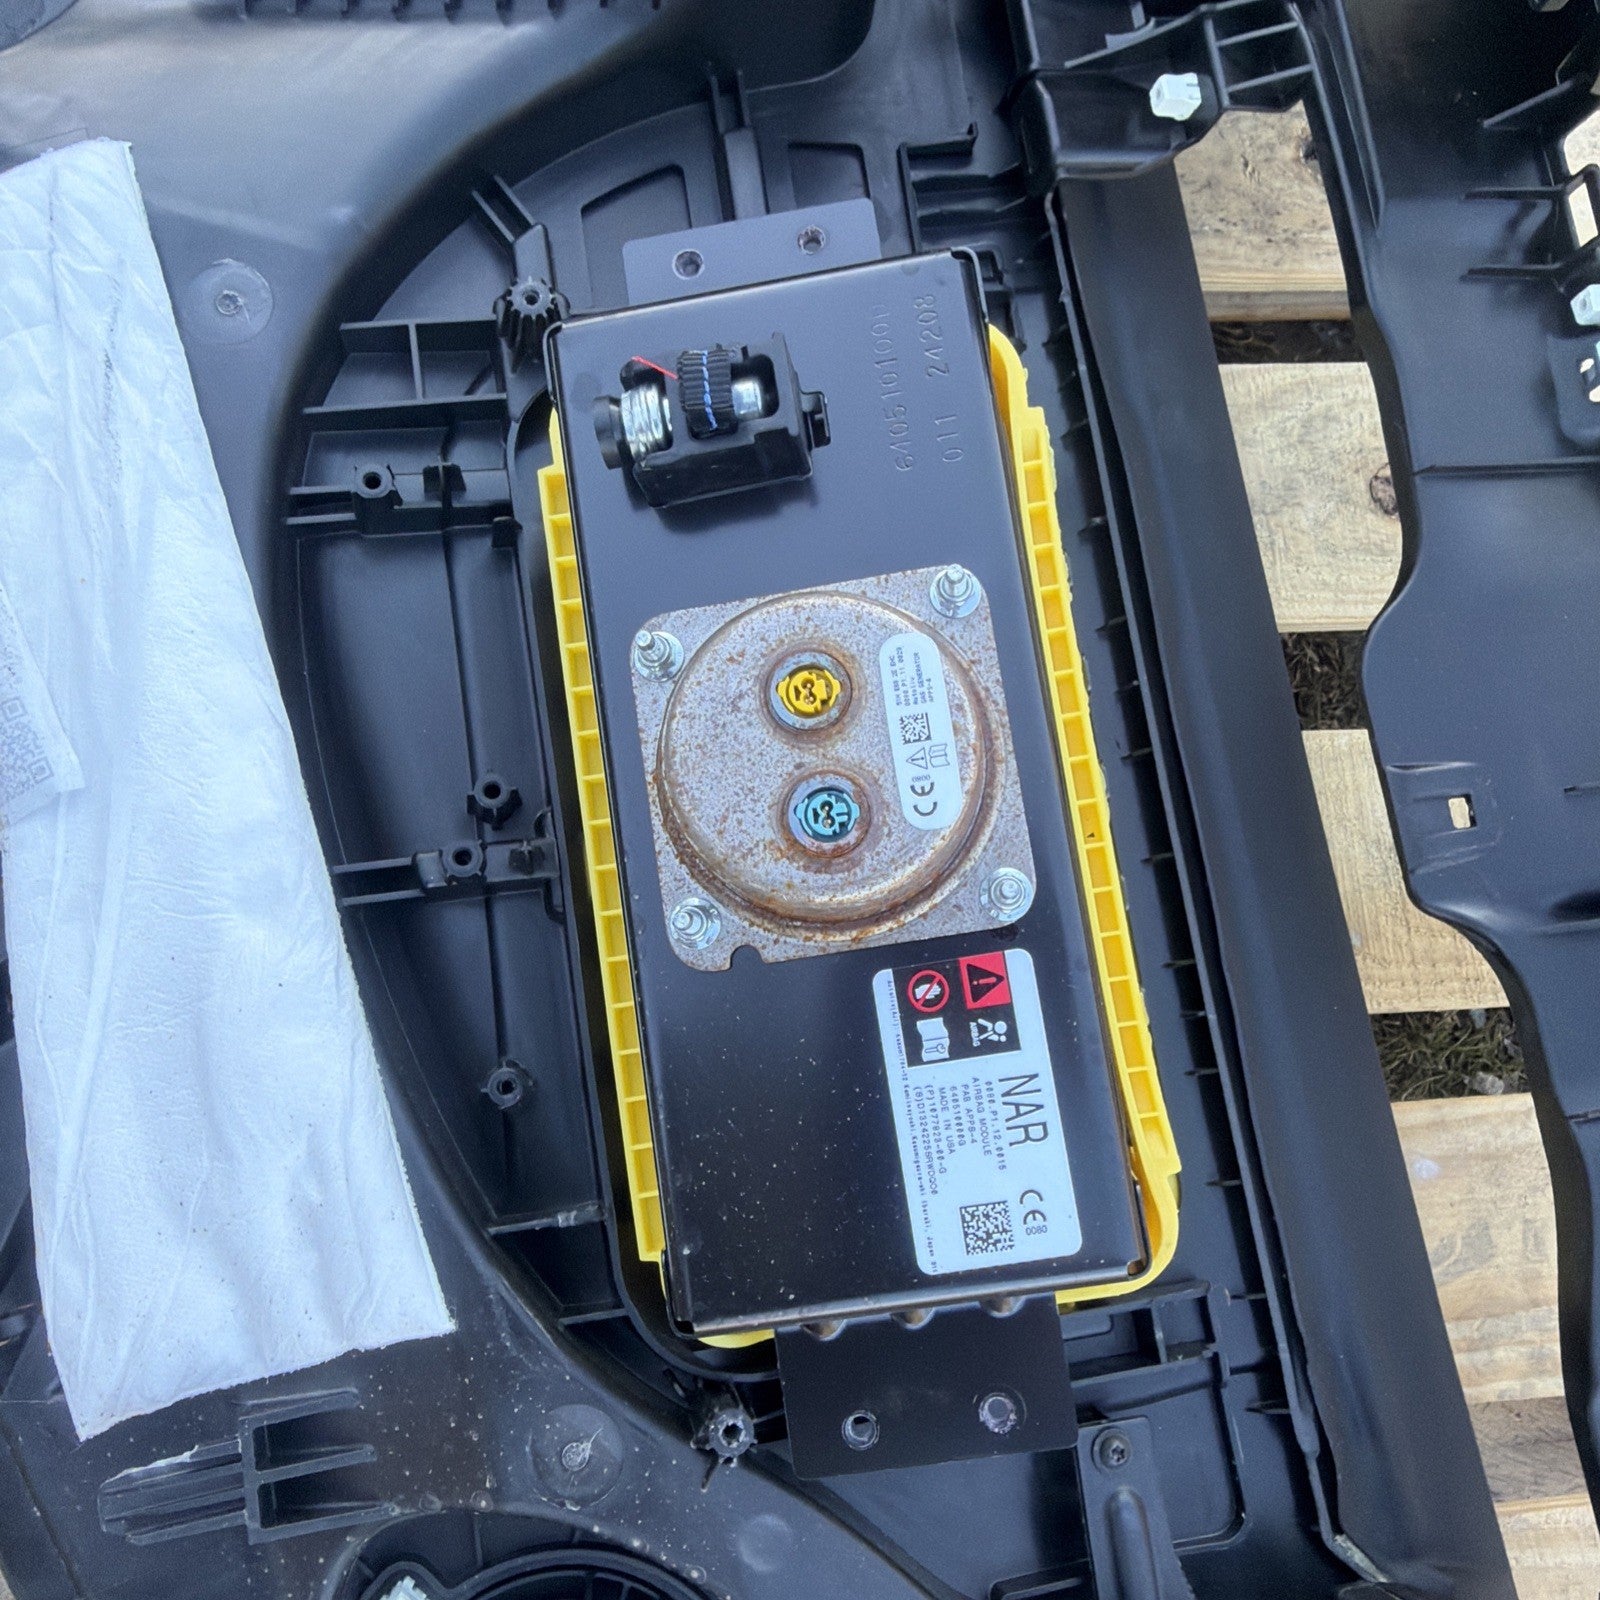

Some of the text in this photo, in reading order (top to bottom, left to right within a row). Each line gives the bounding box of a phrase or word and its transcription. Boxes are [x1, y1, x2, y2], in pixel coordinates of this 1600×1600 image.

[914, 295, 949, 378] 24208
[914, 652, 923, 687] GENERATOR
[968, 1021, 979, 1047] AIRBAG
[938, 1086, 955, 1154] MADE IN USA
[960, 1083, 976, 1144] PAB APPS-4
[972, 1076, 990, 1156] AIRBAG MODULE
[998, 1072, 1049, 1147] NAR
[1025, 1225, 1047, 1235] 0080
